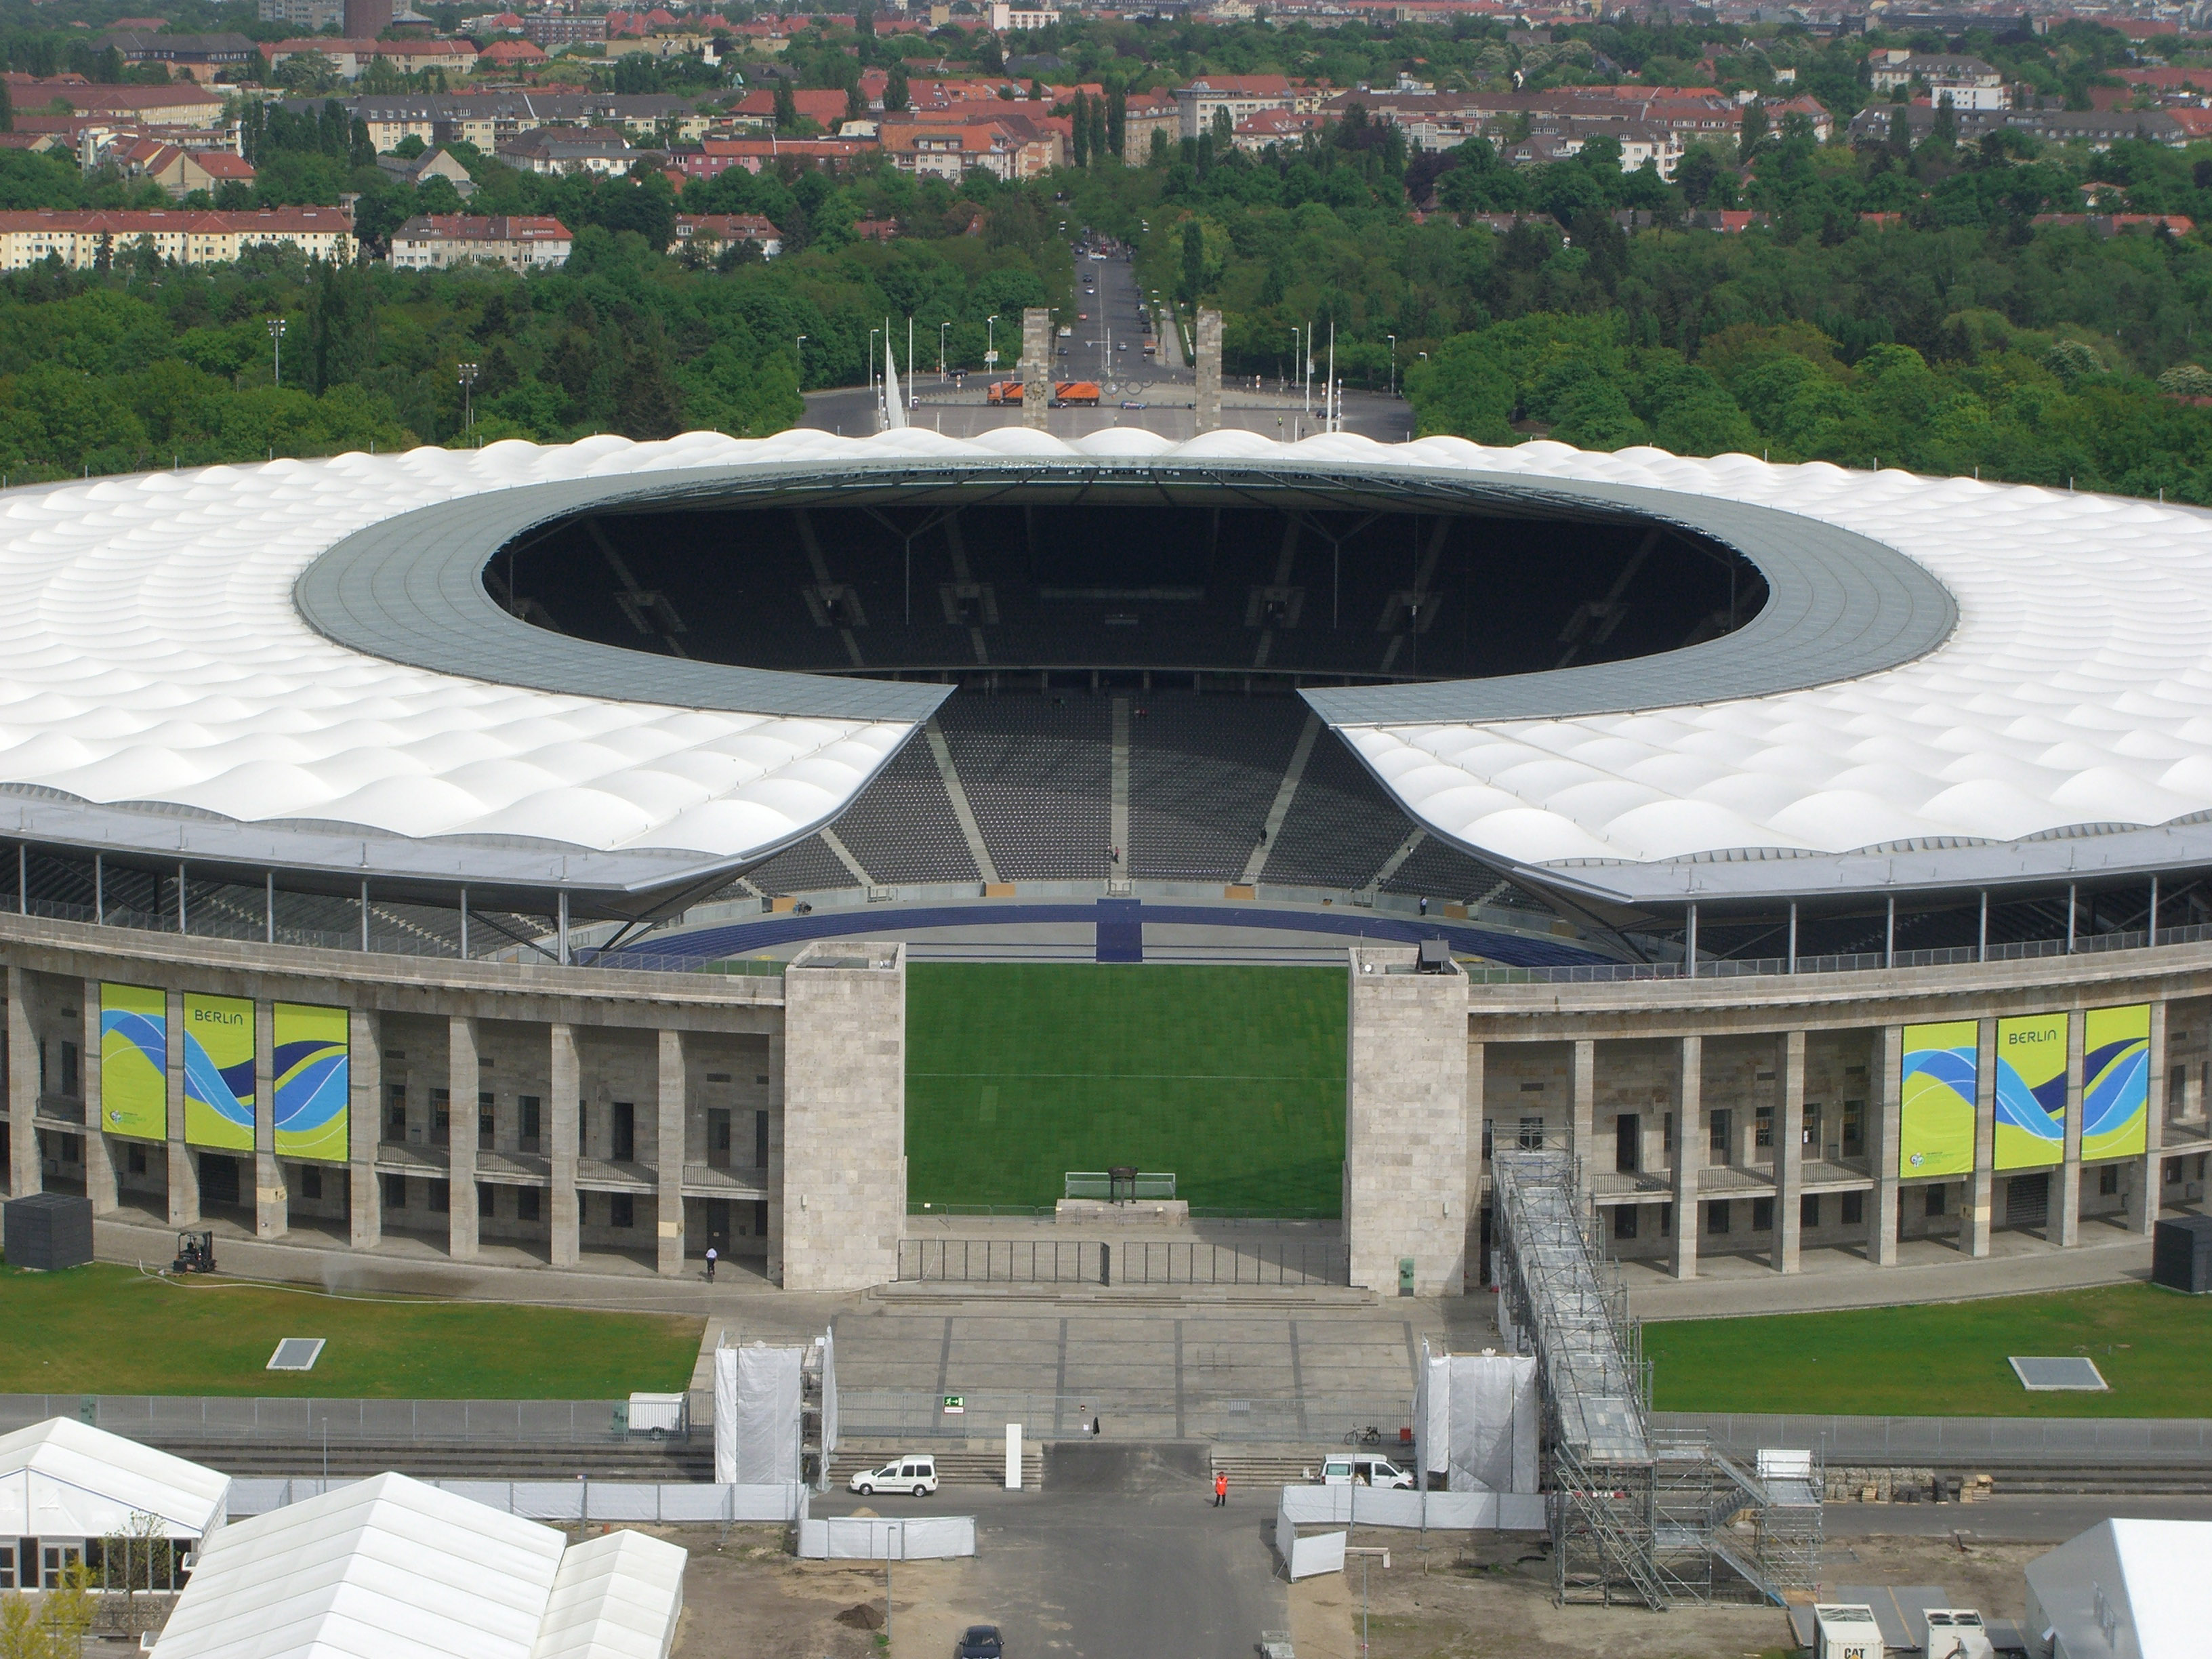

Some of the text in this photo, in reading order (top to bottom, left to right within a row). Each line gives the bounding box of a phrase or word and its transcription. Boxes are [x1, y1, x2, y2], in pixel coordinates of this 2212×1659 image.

[194, 1009, 243, 1025] BERLIN
[2009, 1029, 2056, 1044] BERLIN
[1844, 1647, 1865, 1659] CAT
